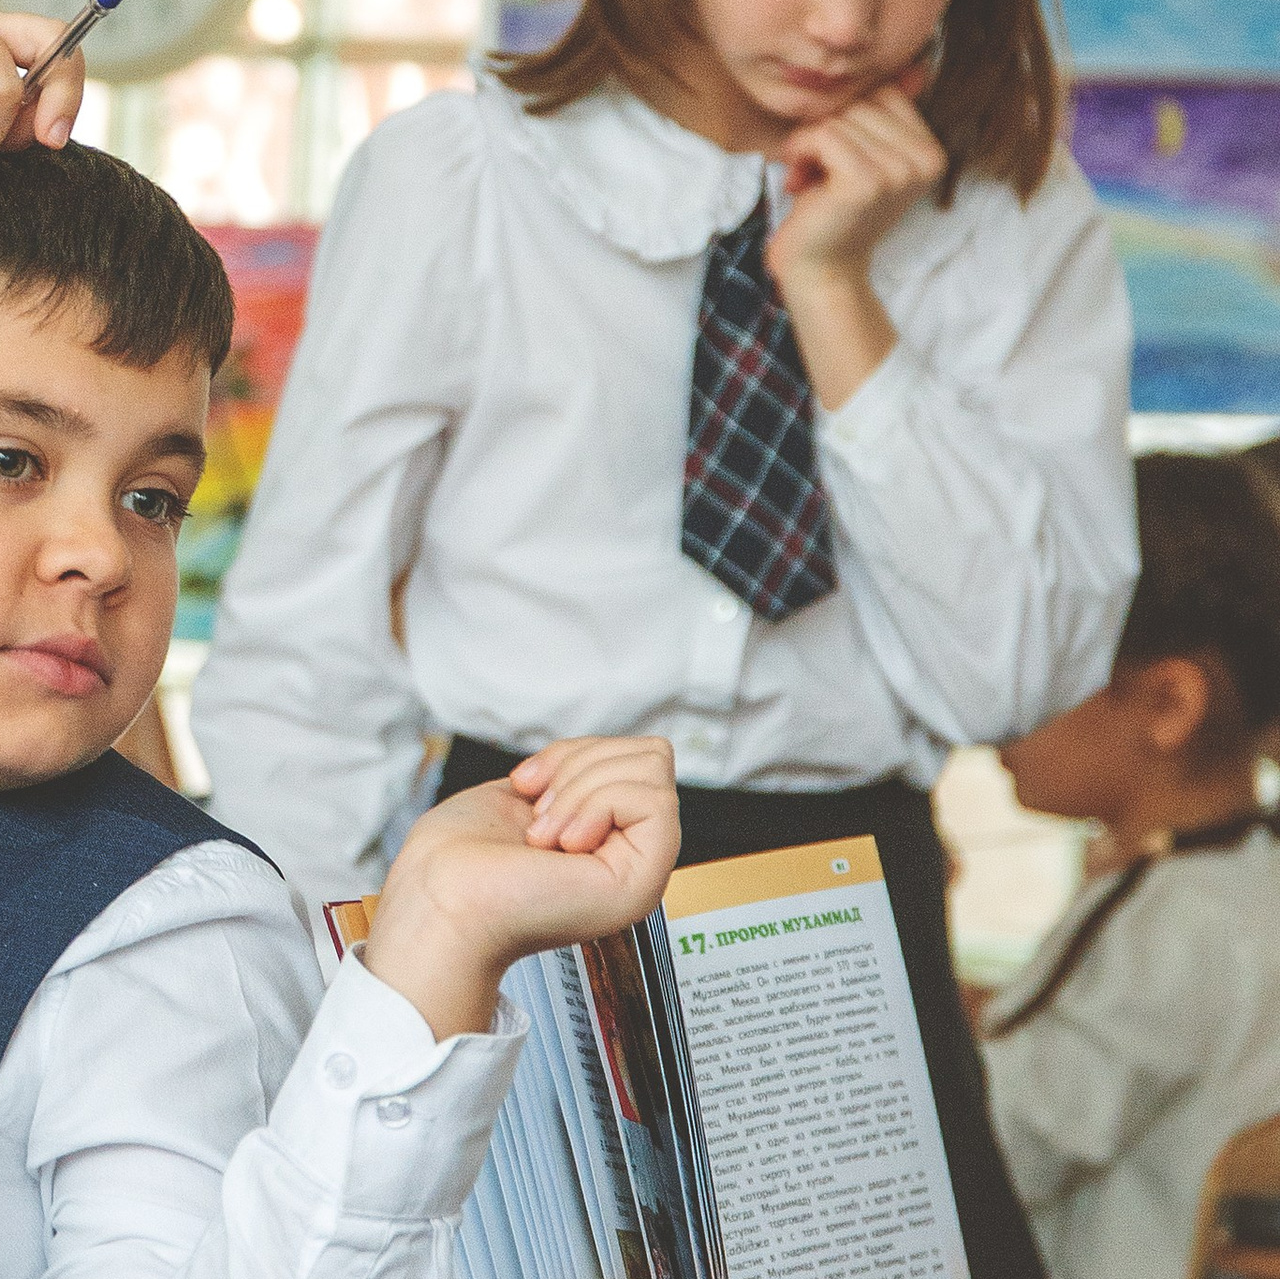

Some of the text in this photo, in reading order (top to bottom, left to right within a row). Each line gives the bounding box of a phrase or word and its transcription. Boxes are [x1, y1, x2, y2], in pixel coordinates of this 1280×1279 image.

[678, 907, 862, 955] 17. ПРОРОК МУХАММАД
